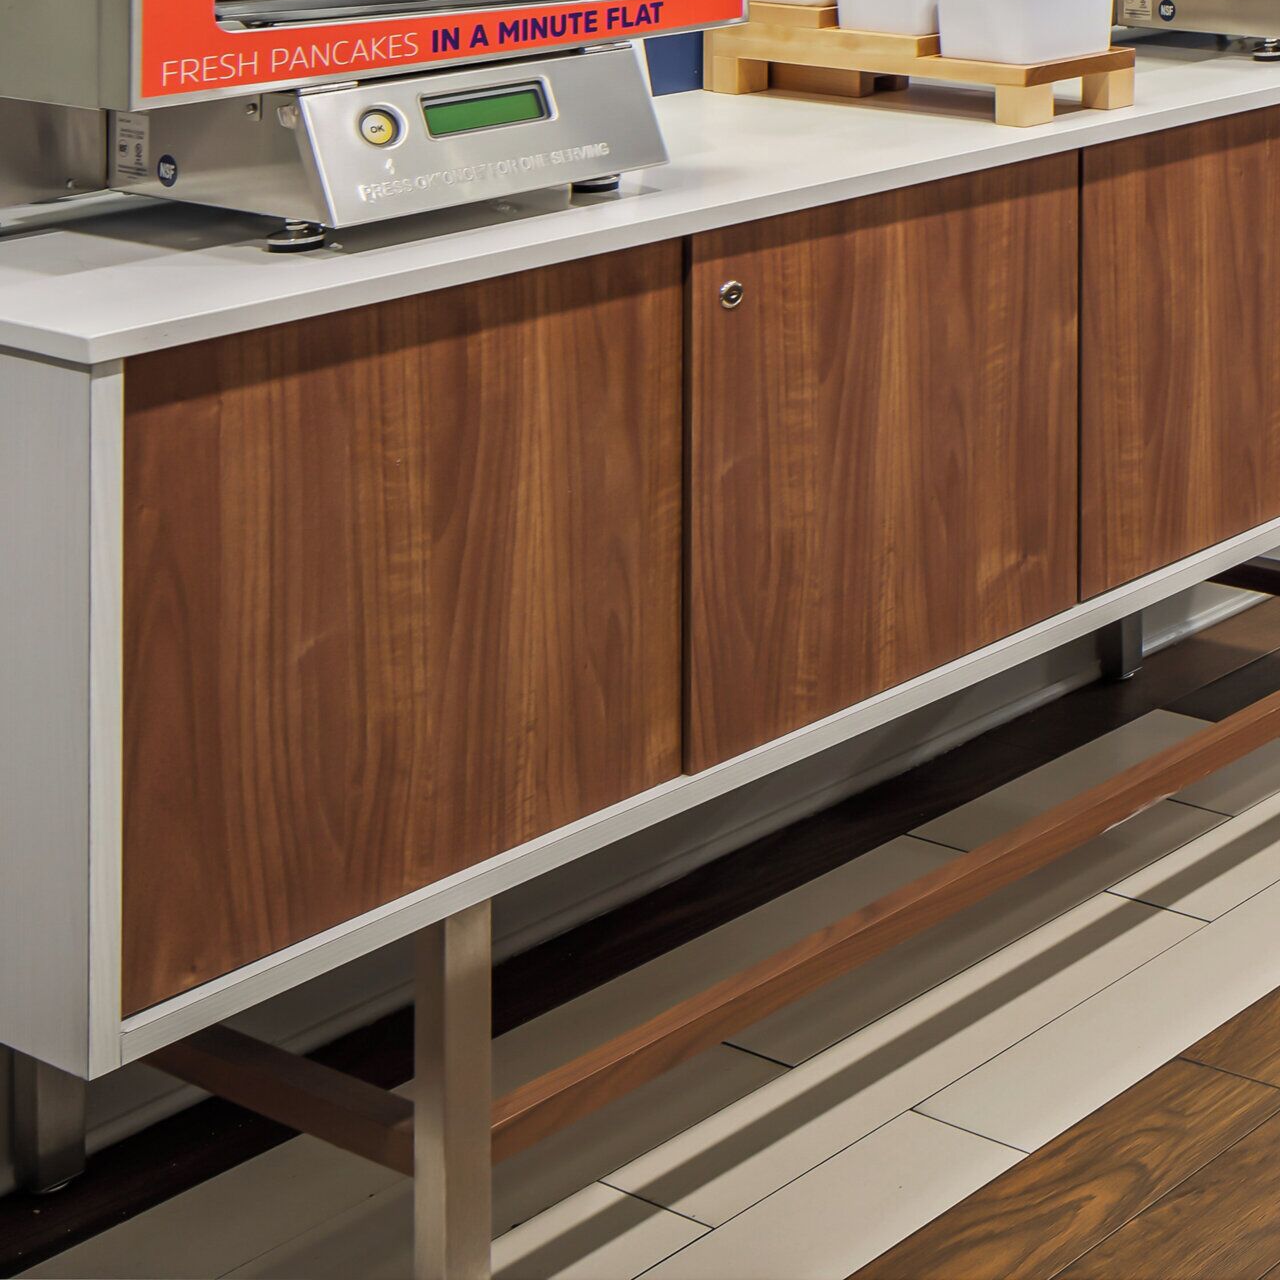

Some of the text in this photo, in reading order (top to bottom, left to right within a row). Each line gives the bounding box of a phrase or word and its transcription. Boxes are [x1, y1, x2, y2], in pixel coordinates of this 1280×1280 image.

[162, 1, 664, 87] FRESH PANCAKES IN A MINUTE FLAT
[370, 124, 385, 134] OK
